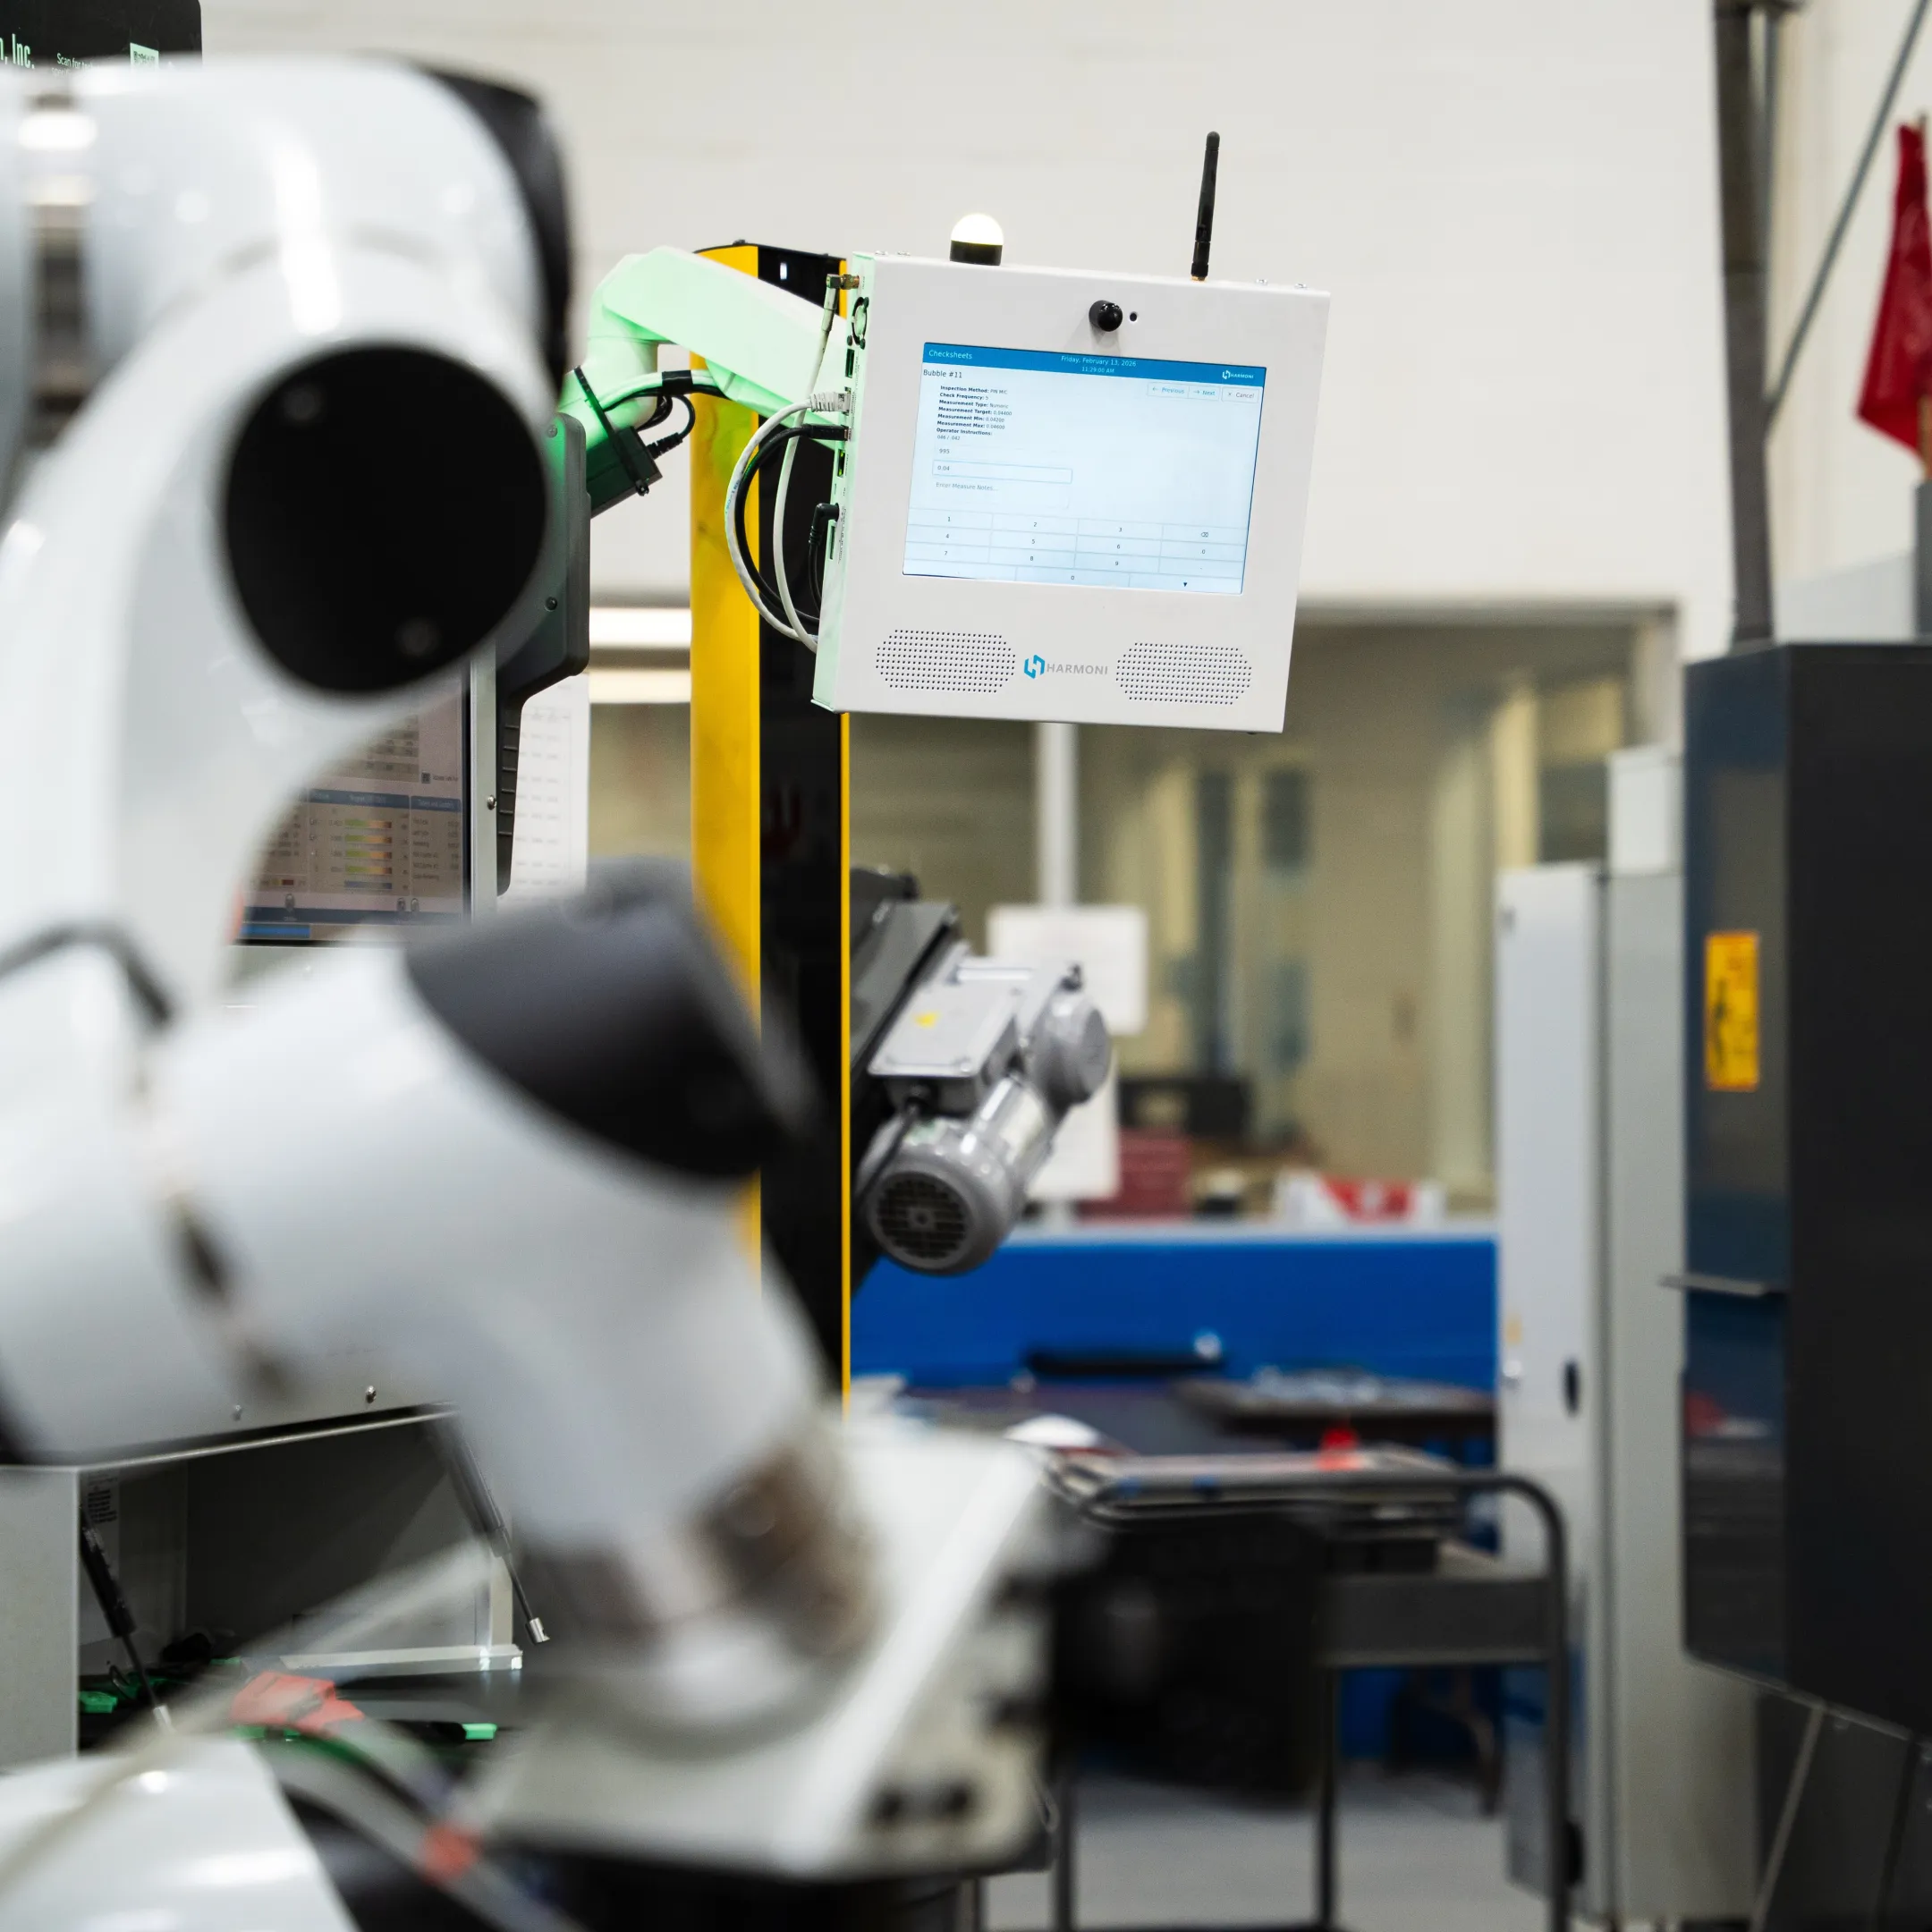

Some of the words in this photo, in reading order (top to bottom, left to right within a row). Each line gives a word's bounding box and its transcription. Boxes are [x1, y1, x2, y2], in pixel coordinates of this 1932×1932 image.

[12, 32, 35, 70] Inc.
[56, 52, 72, 68] Scan
[72, 57, 81, 70] for
[928, 349, 973, 360] Checksheets
[1061, 355, 1080, 364] Friday,
[1082, 357, 1108, 366] February
[923, 369, 946, 377] Bubble
[948, 370, 962, 378] #11
[1235, 391, 1255, 399] Cancel
[1046, 663, 1108, 675] HARMONI
